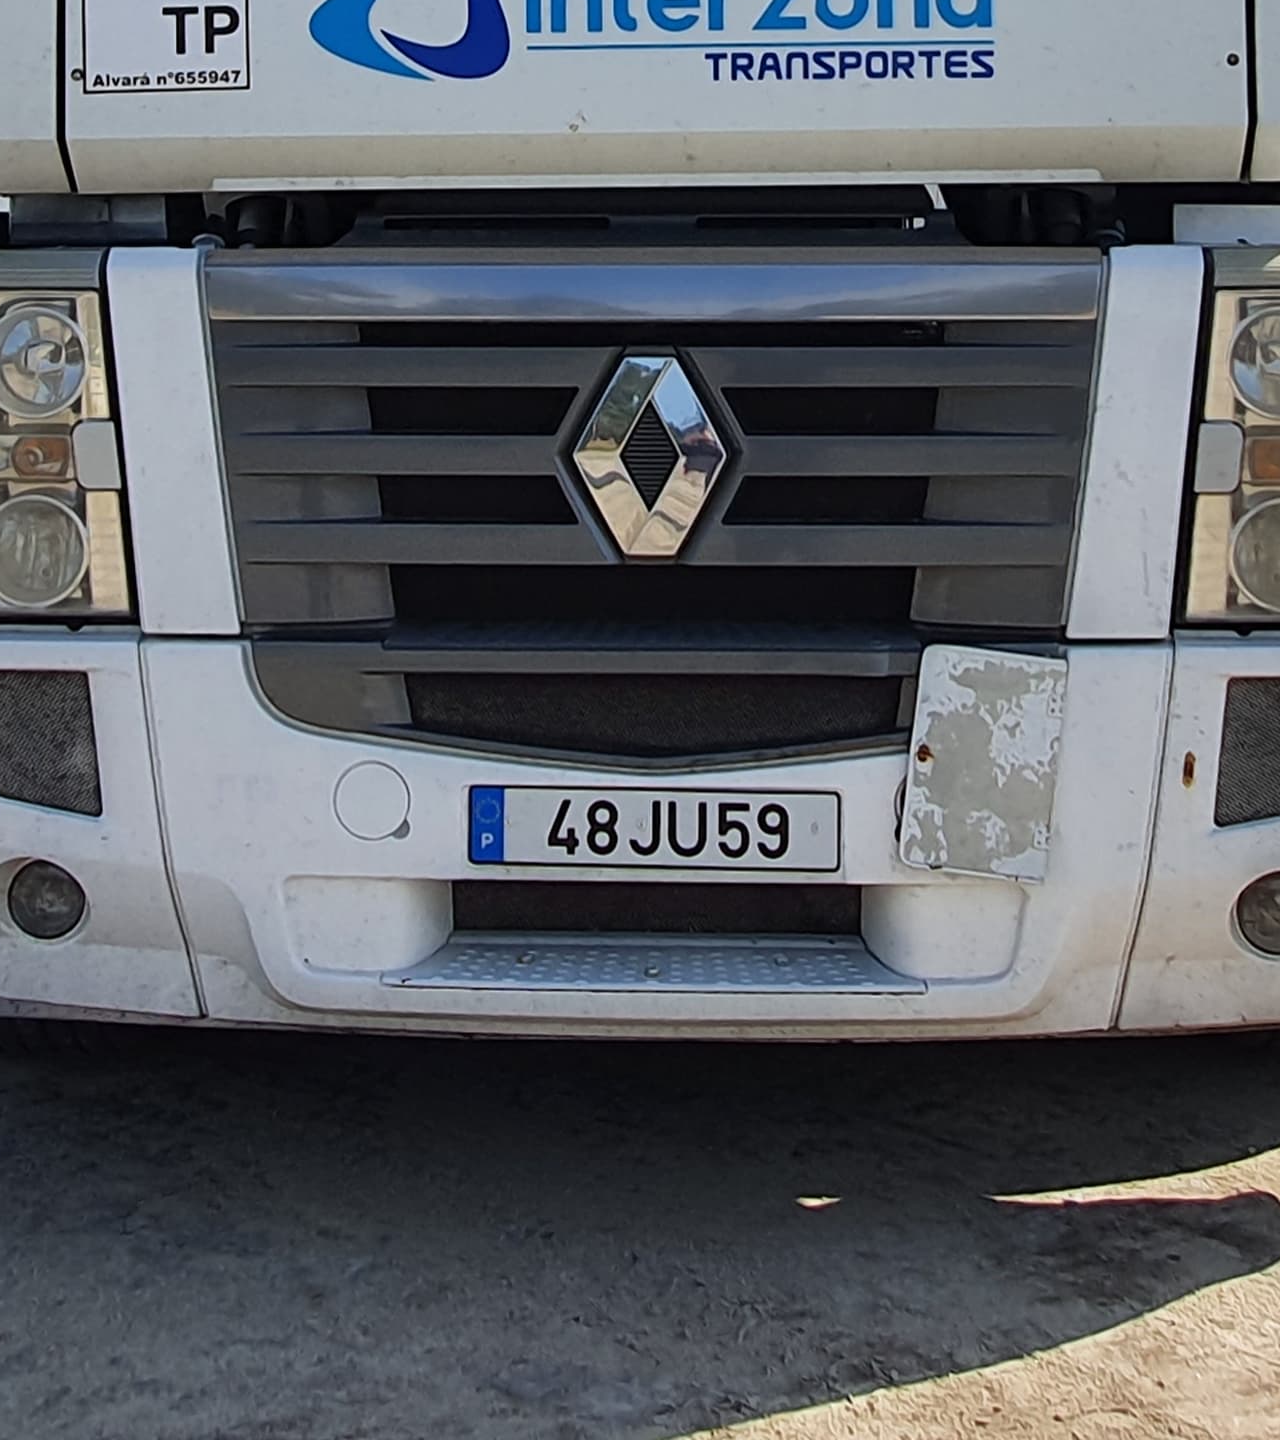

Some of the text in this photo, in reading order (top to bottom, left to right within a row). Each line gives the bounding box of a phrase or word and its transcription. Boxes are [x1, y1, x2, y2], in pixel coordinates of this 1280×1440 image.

[162, 5, 240, 55] TP
[93, 71, 151, 88] Alvará
[705, 49, 996, 83] TRANSPORTES
[481, 833, 495, 849] P
[547, 799, 790, 860] 48JU59
